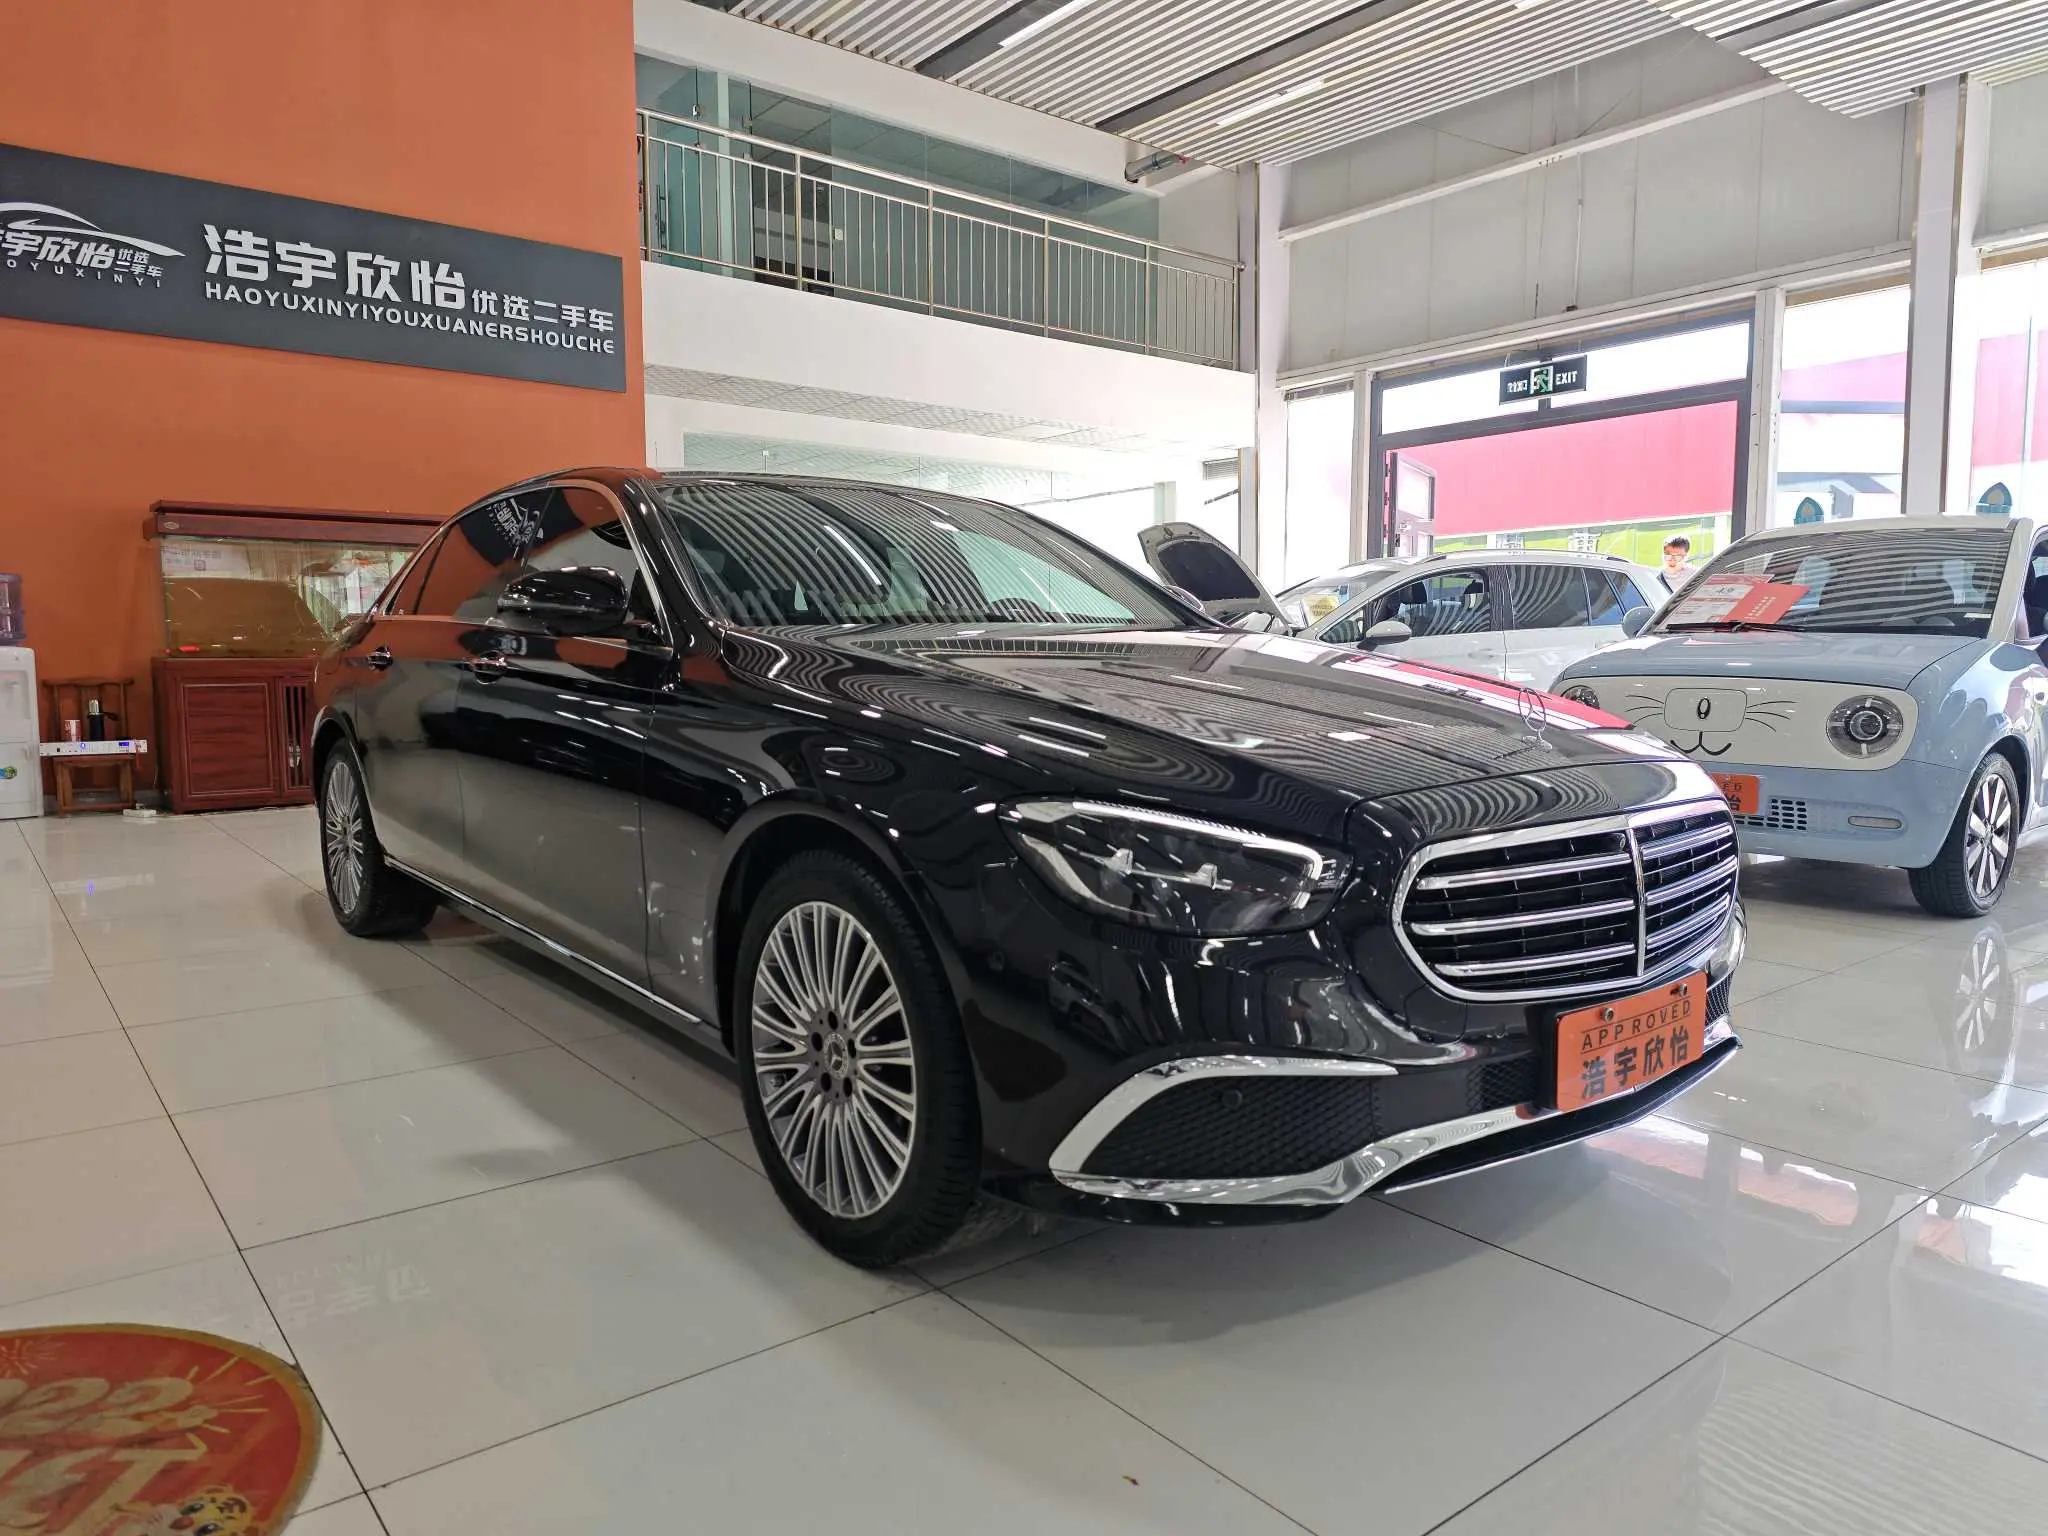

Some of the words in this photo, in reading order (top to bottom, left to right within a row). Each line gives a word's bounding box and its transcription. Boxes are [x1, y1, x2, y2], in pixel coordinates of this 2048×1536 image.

[0, 229, 116, 269] 宇欣怡
[203, 223, 466, 310] 浩宇欣怡
[471, 287, 614, 332] 优选二手车
[205, 281, 615, 354] HAOYUXINYIYOUXUANERSHOUCHE
[1555, 371, 1578, 386] EXIT
[1581, 1000, 1691, 1051] APPROVED
[1580, 1025, 1690, 1100] 浩宇欣怡
